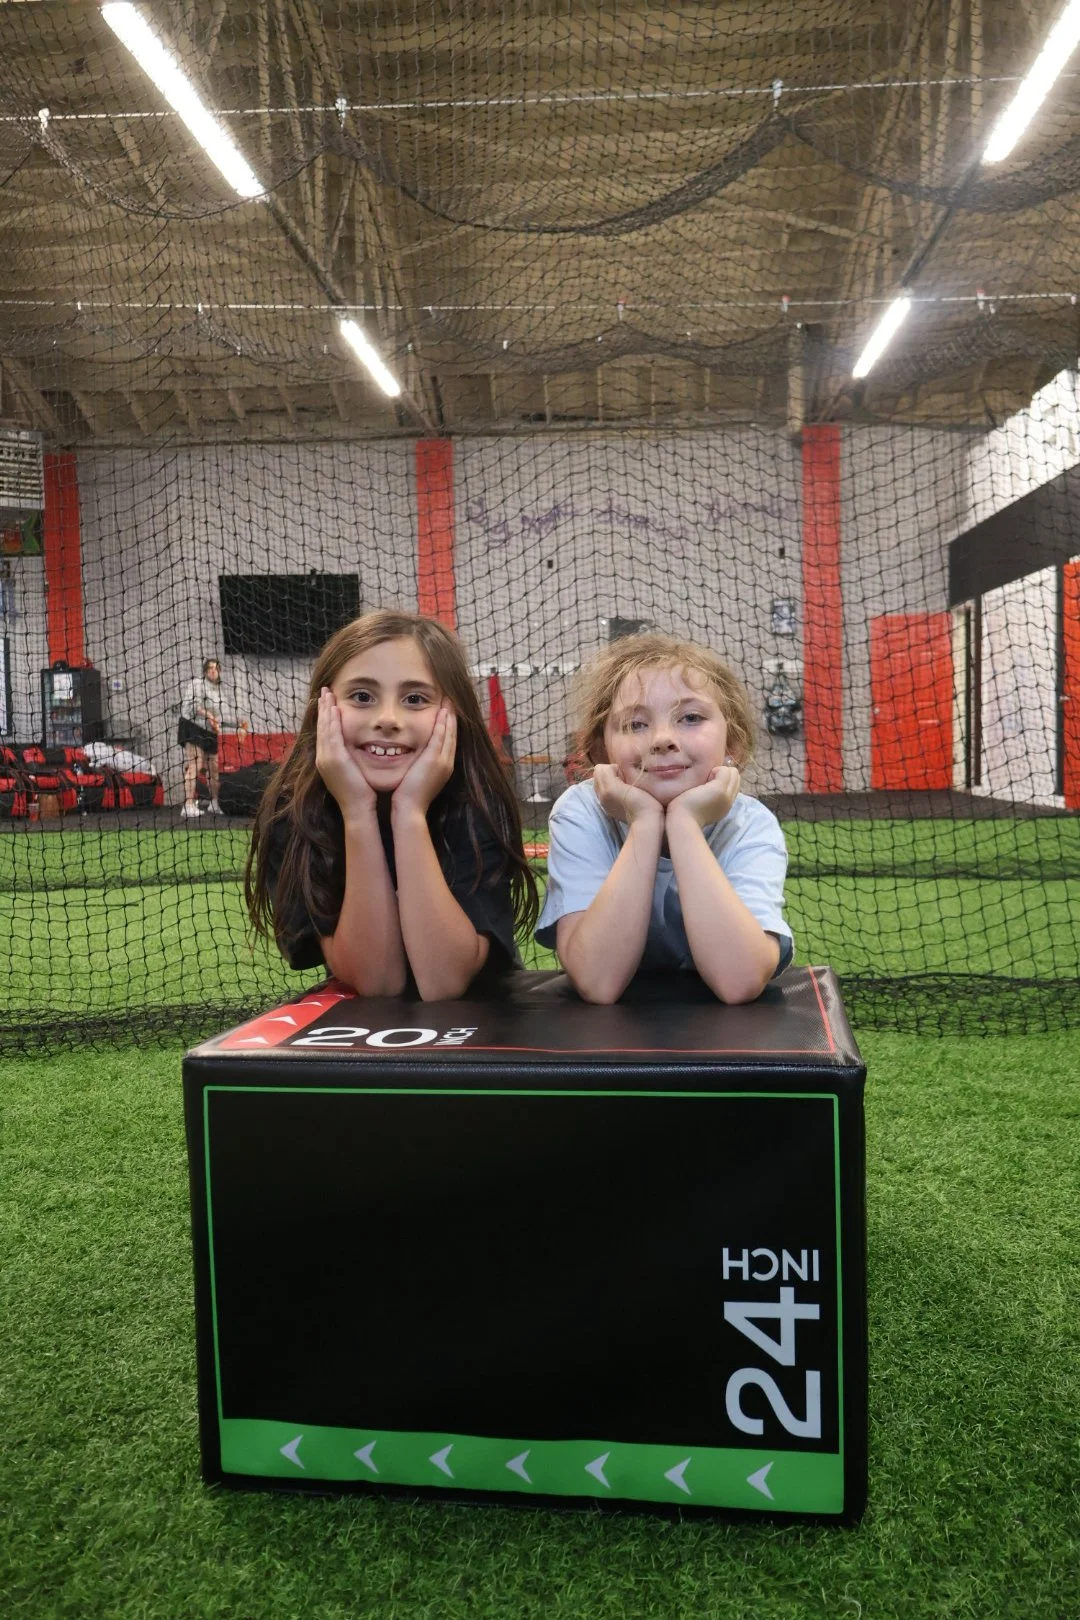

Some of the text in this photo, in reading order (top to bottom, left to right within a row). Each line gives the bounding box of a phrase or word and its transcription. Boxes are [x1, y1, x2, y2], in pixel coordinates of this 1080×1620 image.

[290, 1027, 437, 1047] 20
[433, 1027, 479, 1046] INCH
[722, 1248, 820, 1282] INCH
[723, 1287, 821, 1438] 24
